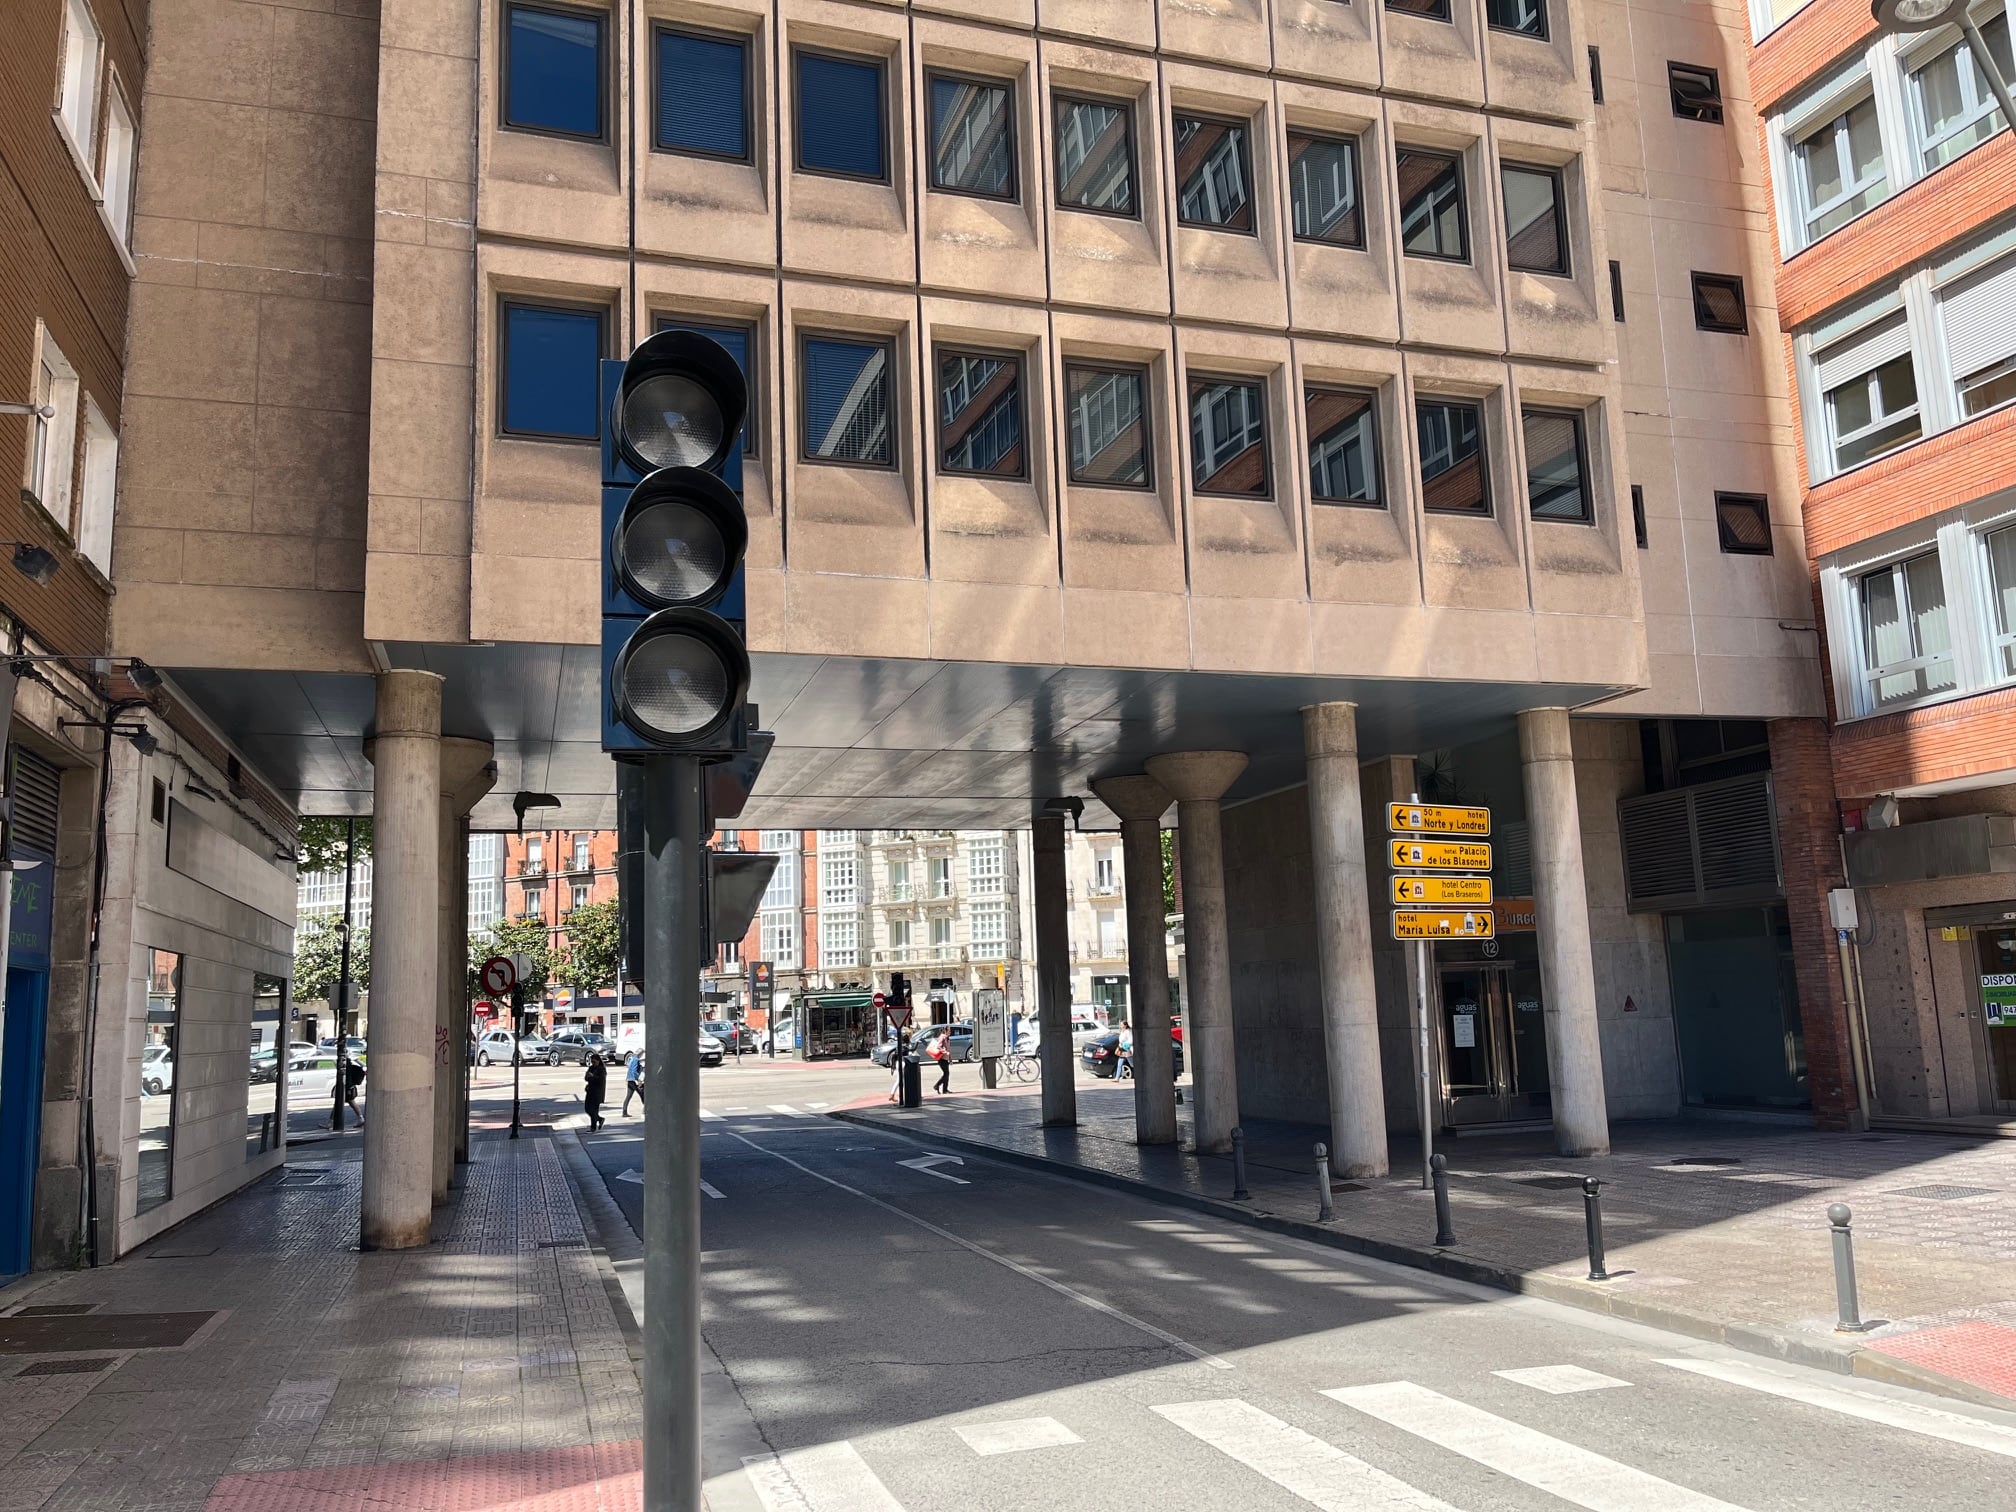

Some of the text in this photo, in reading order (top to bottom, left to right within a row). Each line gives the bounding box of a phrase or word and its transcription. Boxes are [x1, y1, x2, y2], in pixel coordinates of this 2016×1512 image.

[1467, 811, 1485, 819] hotel
[1424, 818, 1485, 830] Norte y Londres
[1459, 846, 1486, 856] Palacio
[1440, 857, 1451, 865] los
[1453, 857, 1487, 866] Blasones
[1441, 890, 1483, 898] (Los Braseros)
[1398, 914, 1417, 922] hotel
[1427, 925, 1450, 934] Luisa
[1485, 942, 1496, 953] 12
[1455, 1004, 1477, 1014] aguas
[1517, 1001, 1539, 1011] aguas
